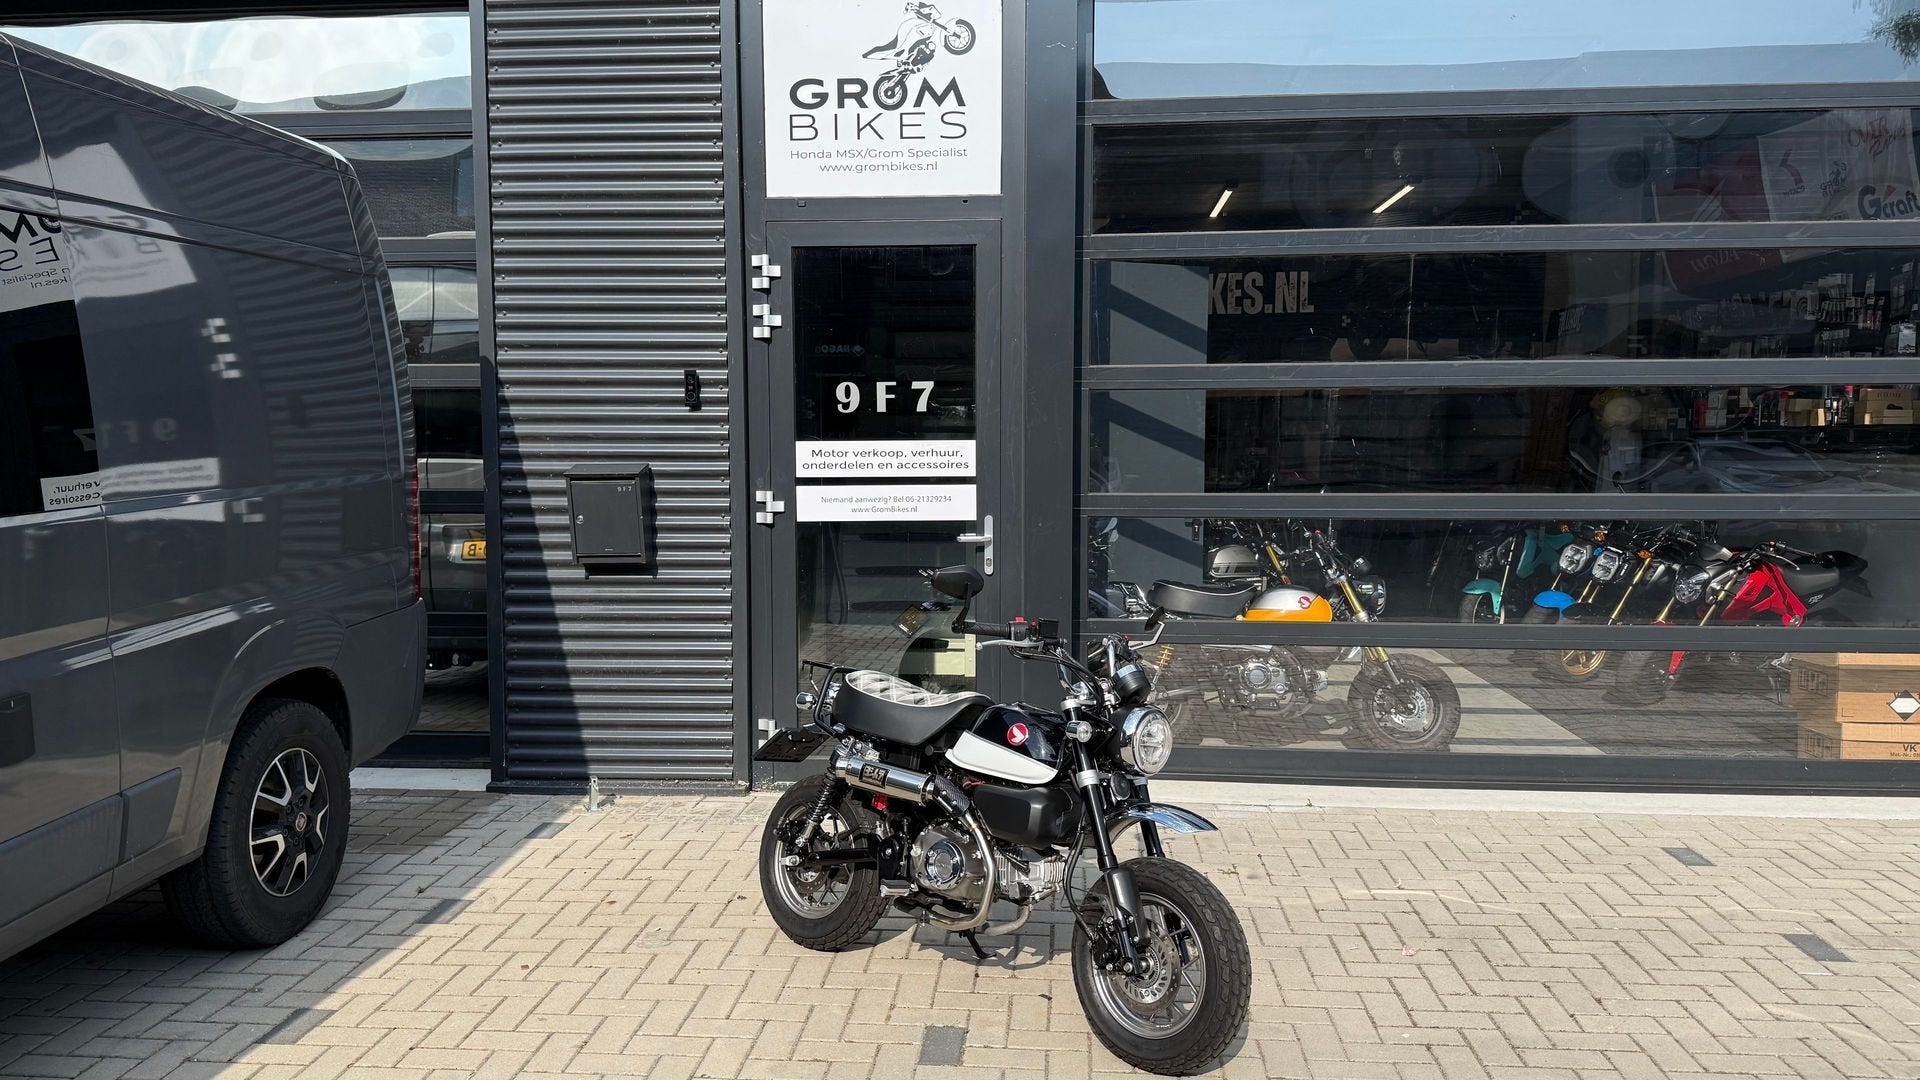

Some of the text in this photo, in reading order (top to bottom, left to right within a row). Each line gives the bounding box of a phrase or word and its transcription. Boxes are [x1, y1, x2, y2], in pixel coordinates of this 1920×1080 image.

[789, 76, 966, 111] GROM
[789, 111, 967, 141] BIKES
[790, 147, 968, 159] Honda MSX/Grom Specialist
[819, 161, 938, 173] www.grombikes.nl
[835, 380, 935, 414] 9 F 7
[811, 448, 963, 459] Motor verkoop, verhuur,
[802, 460, 969, 470] onderdelen en accessoires
[855, 496, 892, 505] aanwezig?
[893, 495, 904, 503] Bel
[905, 495, 952, 503] 06-21329234
